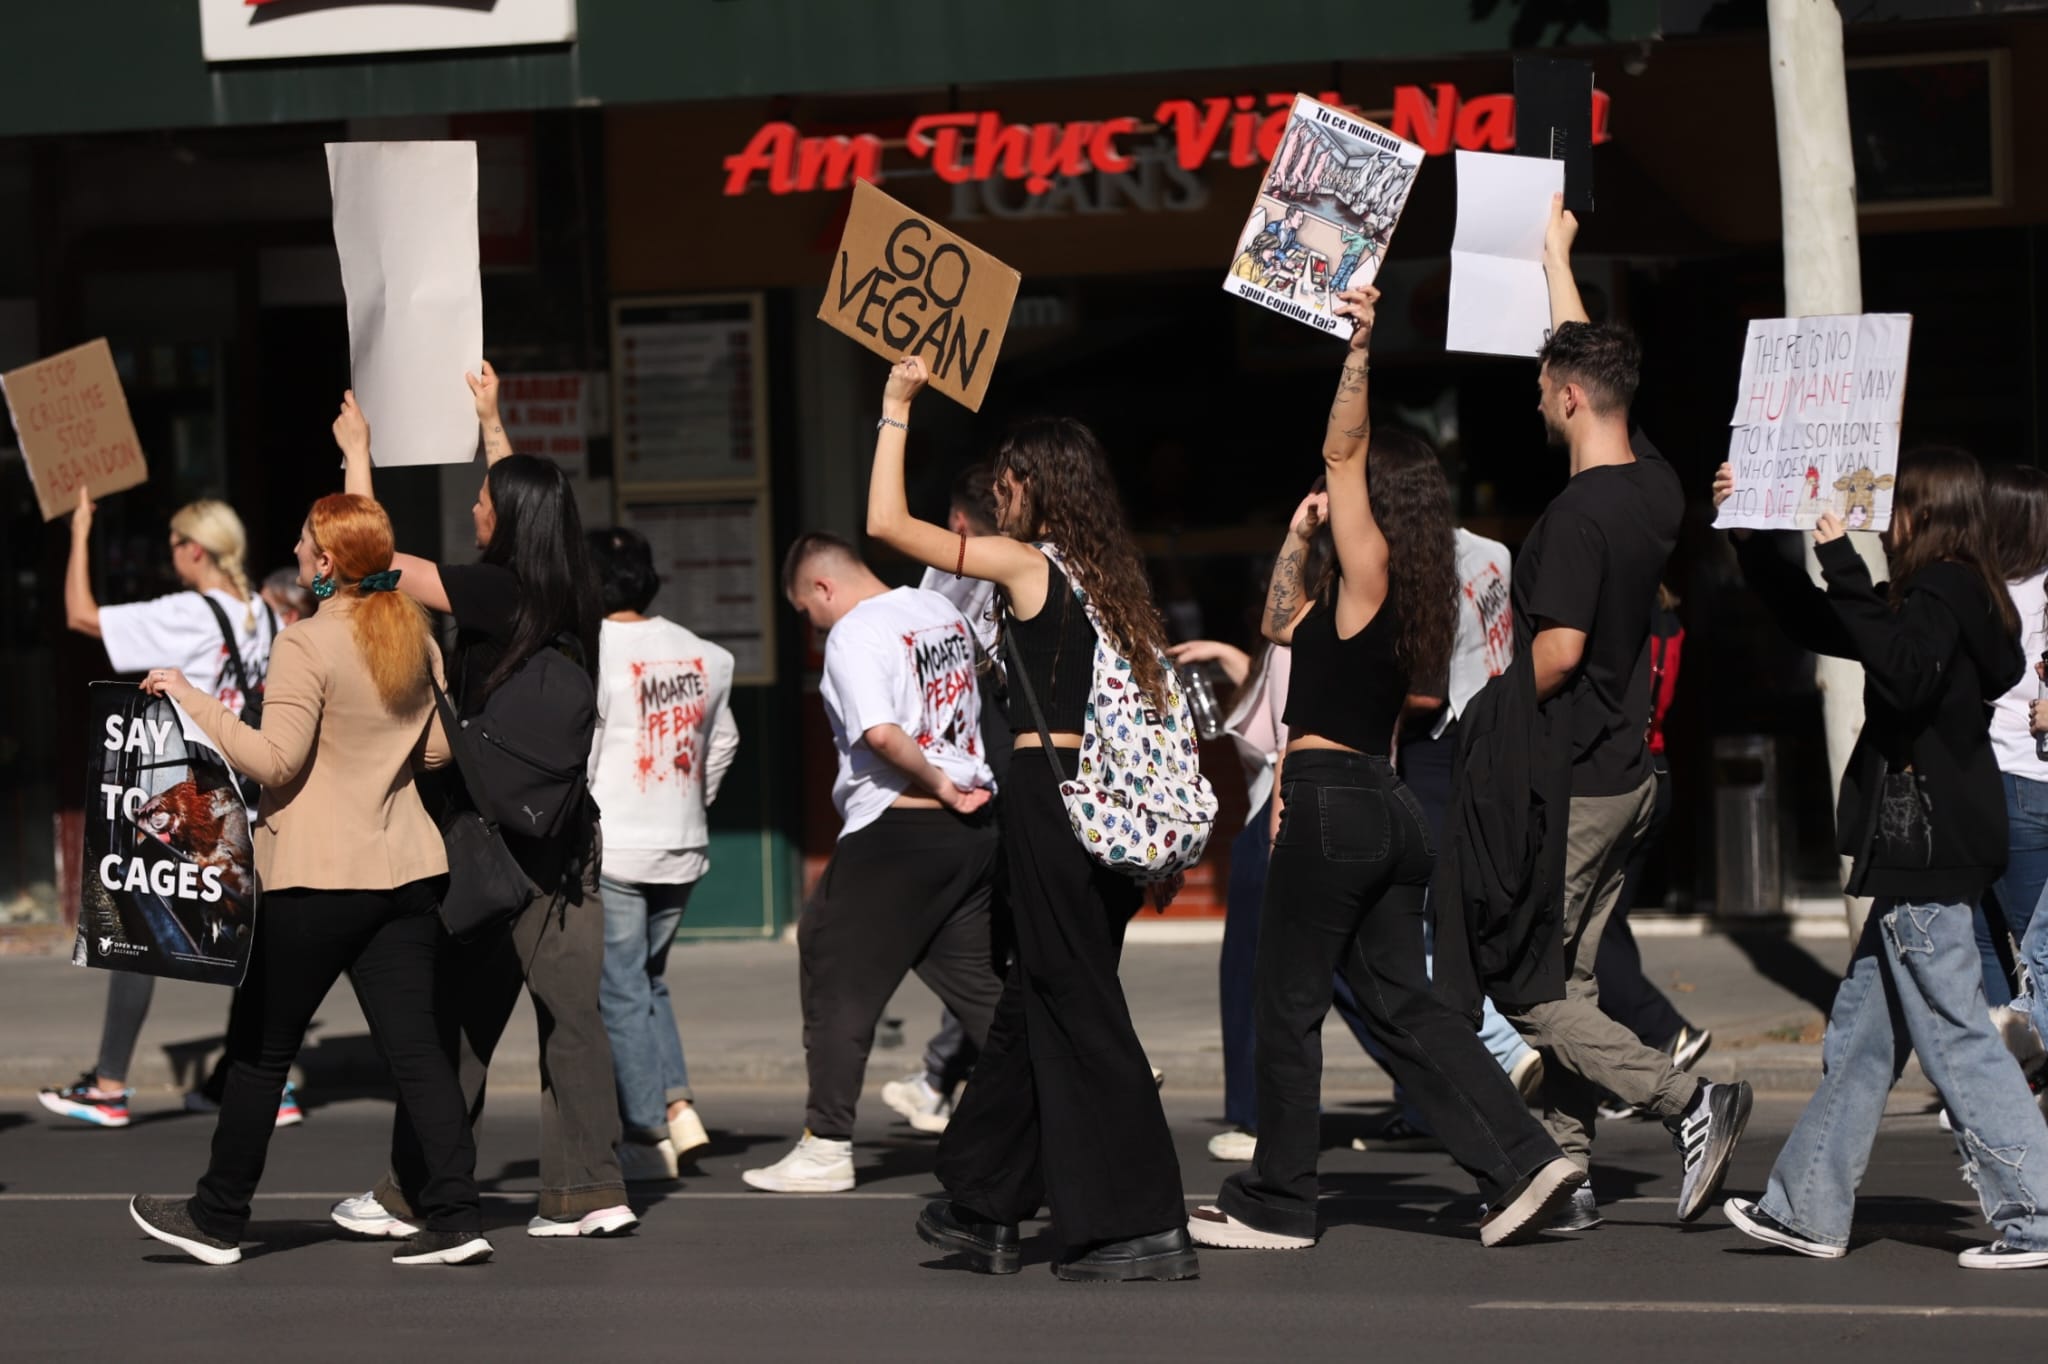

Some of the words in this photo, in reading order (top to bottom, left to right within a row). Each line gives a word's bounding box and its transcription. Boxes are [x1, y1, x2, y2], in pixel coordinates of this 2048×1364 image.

[1315, 106, 1331, 124] Tu
[1331, 116, 1346, 130] ce
[1347, 121, 1402, 153] minciuni
[1390, 82, 1612, 157] Na
[885, 218, 971, 309] GO
[838, 250, 990, 392] VEGAN
[1238, 283, 1266, 306] spui
[1265, 294, 1313, 323] copiilor
[1754, 334, 1803, 375] THERE
[1825, 331, 1852, 365] NO
[36, 358, 77, 395] STOP
[1747, 370, 1855, 421] HUMANE
[1859, 368, 1897, 401] WAY
[56, 417, 97, 455] STOP
[1741, 425, 1761, 455] TO
[1765, 426, 1800, 451] KILL
[1803, 421, 1883, 450] SOMEONE
[46, 438, 137, 503] ABANDON
[1738, 458, 1774, 480] WHO
[1733, 487, 1758, 517] TO
[916, 634, 969, 691] MOARTE
[641, 672, 704, 720] MOARTE
[926, 678, 945, 710] PE
[103, 714, 174, 756] SAY
[648, 710, 669, 738] PE
[99, 853, 223, 903] CAGES
